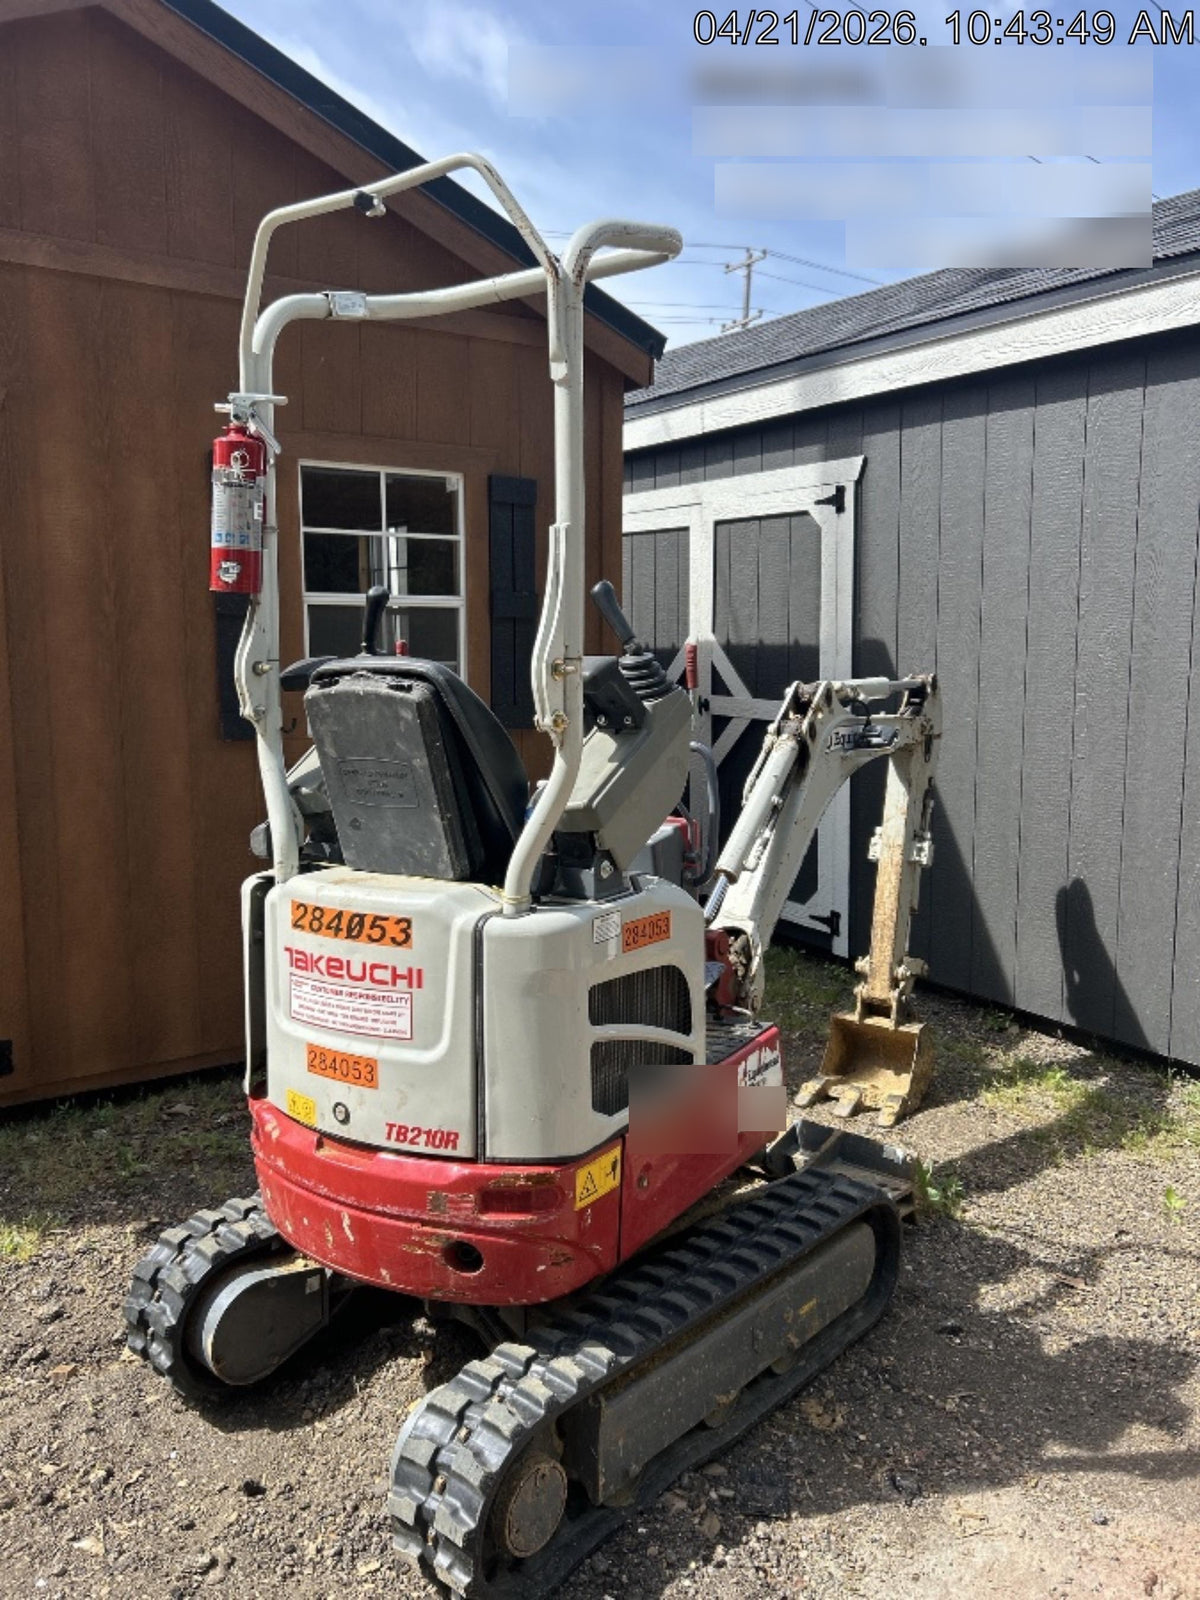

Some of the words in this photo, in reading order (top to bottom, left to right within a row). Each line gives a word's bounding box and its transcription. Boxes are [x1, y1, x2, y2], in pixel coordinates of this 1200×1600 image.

[625, 916, 670, 947] 284053
[308, 1050, 375, 1083] 284053
[385, 1122, 460, 1151] TB210R
